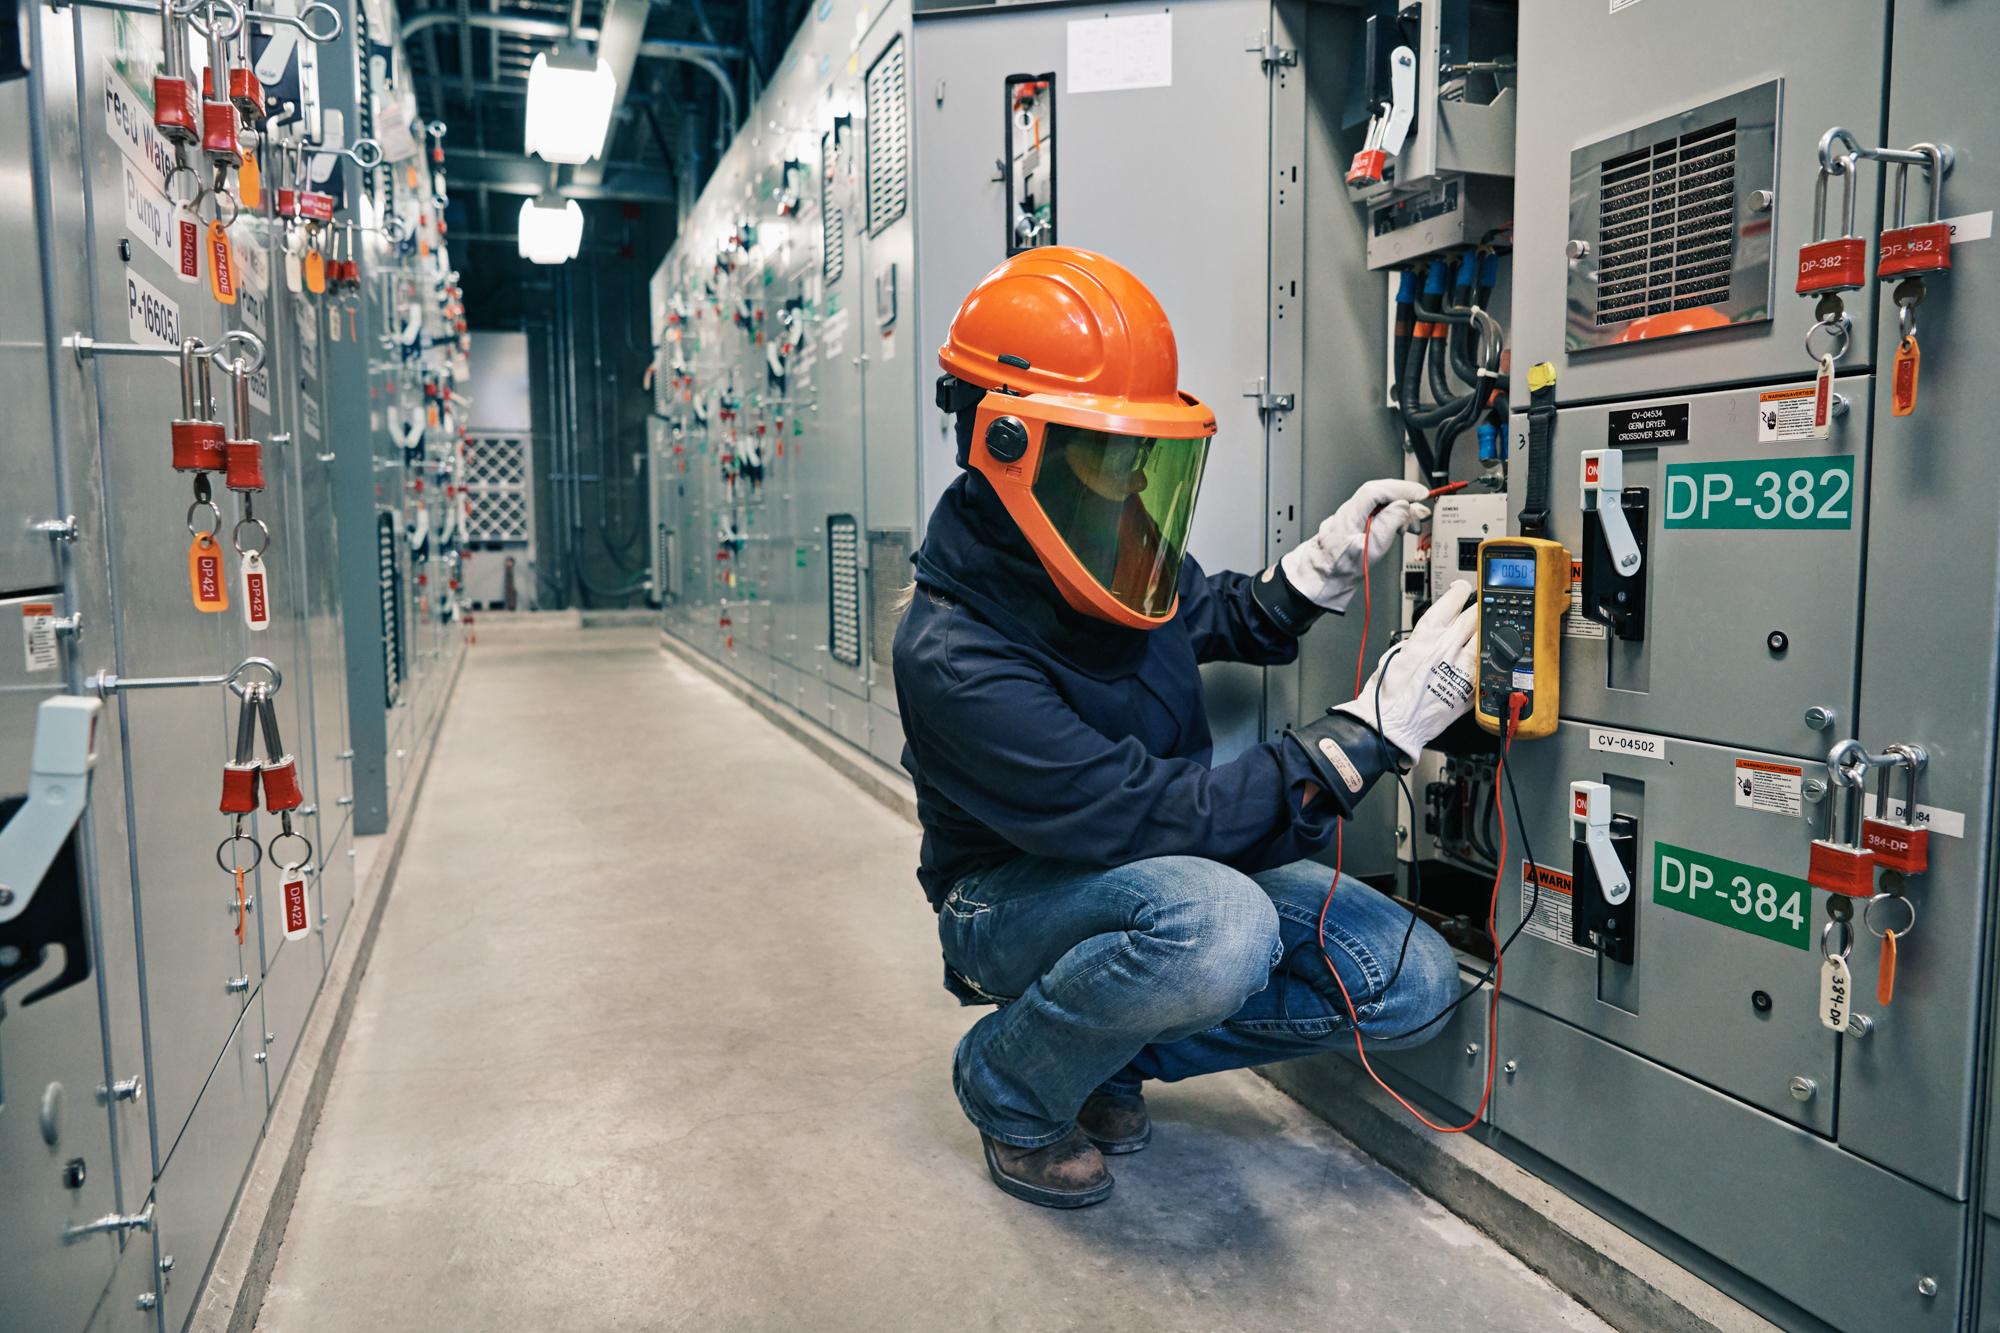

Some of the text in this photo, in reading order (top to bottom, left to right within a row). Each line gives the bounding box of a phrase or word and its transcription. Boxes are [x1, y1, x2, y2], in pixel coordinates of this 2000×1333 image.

[106, 77, 138, 146] Feed
[126, 169, 173, 249] Pump J
[183, 222, 195, 276] DP420E
[215, 241, 230, 295] DP420E
[1801, 255, 1842, 273] DP-382
[128, 278, 180, 346] P-16605J
[1619, 429, 1676, 440] CROSSOVER SCREW
[1628, 420, 1666, 430] GERM DRYER
[1632, 410, 1663, 420] CV-04534
[1518, 433, 1526, 450] 3
[1666, 468, 1850, 520] DP-382
[202, 559, 216, 598] DP421
[252, 579, 263, 618] DP421
[1598, 735, 1655, 753] CV-04502
[1576, 798, 1587, 809] ON
[1867, 834, 1909, 852] 384-DP
[290, 887, 303, 927] DP422
[1660, 855, 1805, 931] DP-384
[1830, 975, 1846, 1026] 384-DP
